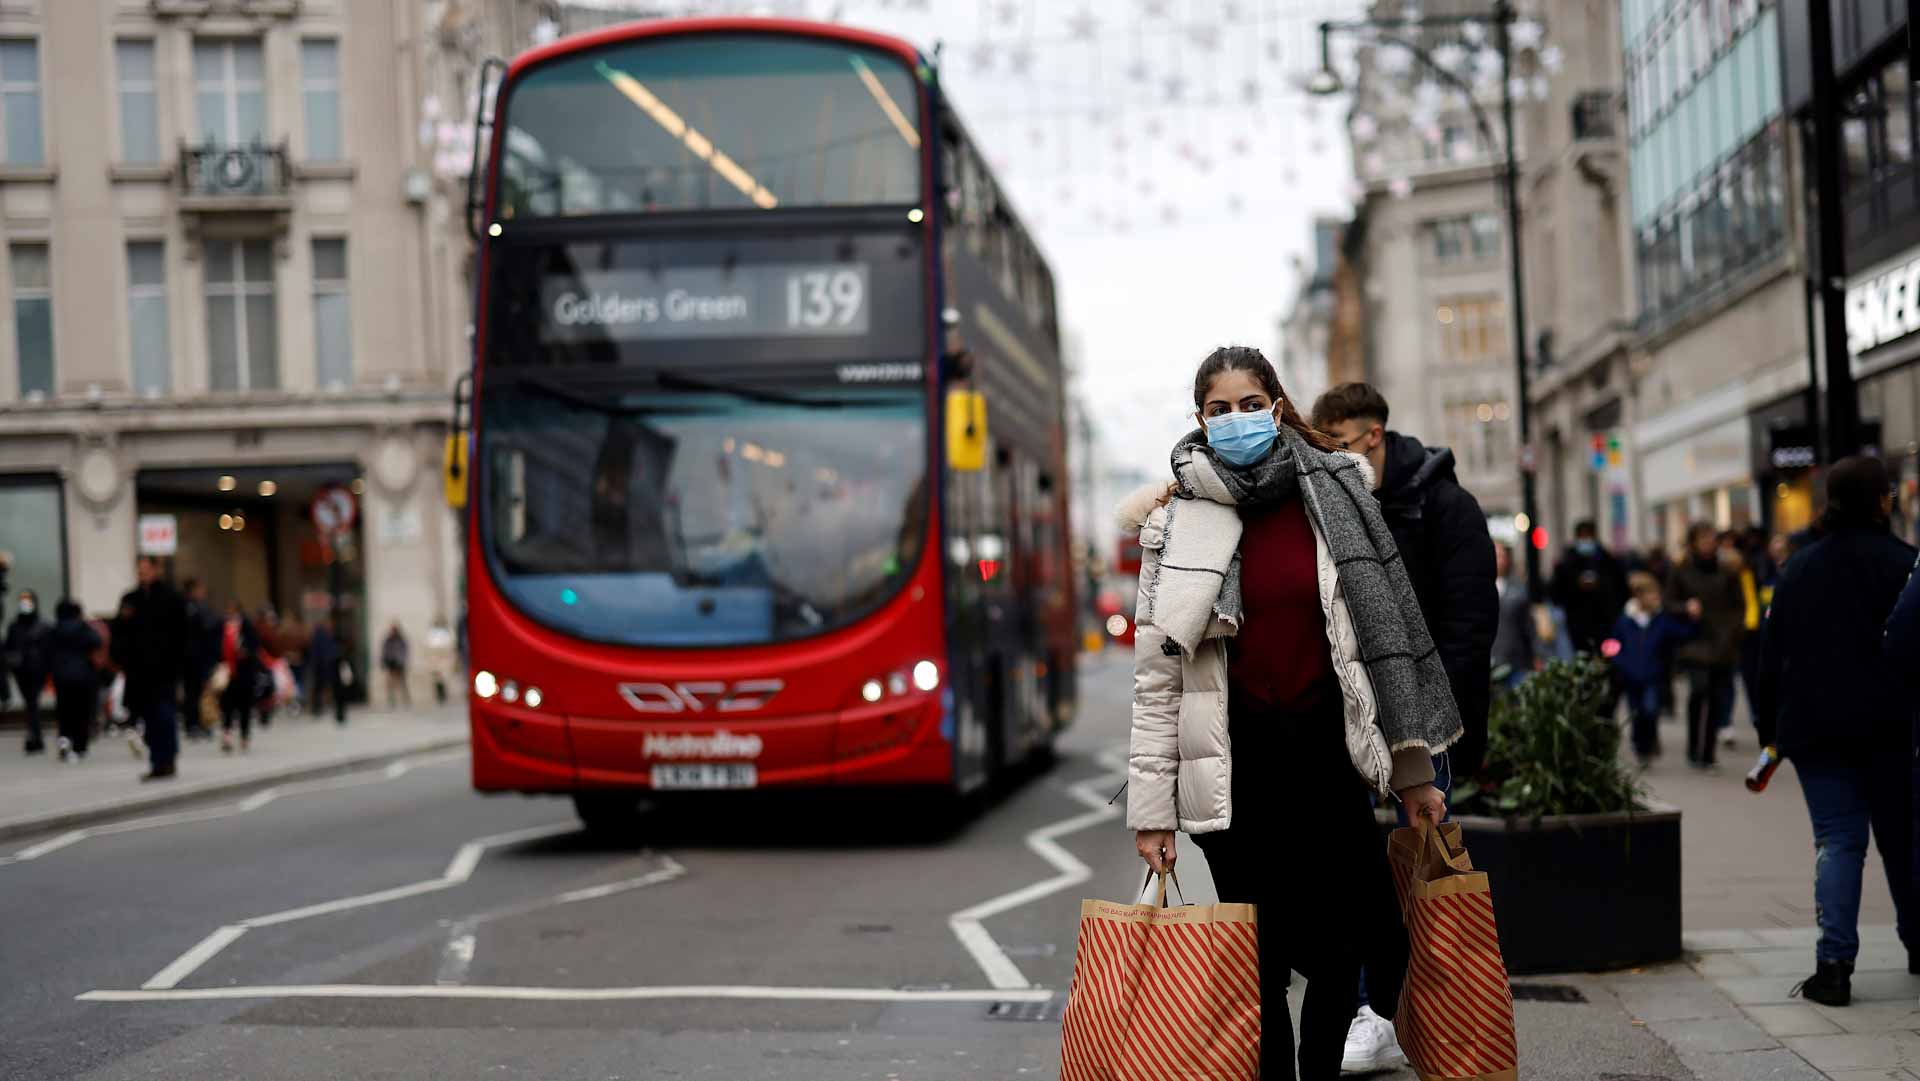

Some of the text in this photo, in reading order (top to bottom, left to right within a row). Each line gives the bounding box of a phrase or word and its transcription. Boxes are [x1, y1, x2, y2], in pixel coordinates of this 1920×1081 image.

[554, 289, 748, 325] Golders Green
[787, 272, 863, 326] 139
[642, 731, 763, 759] Metroline
